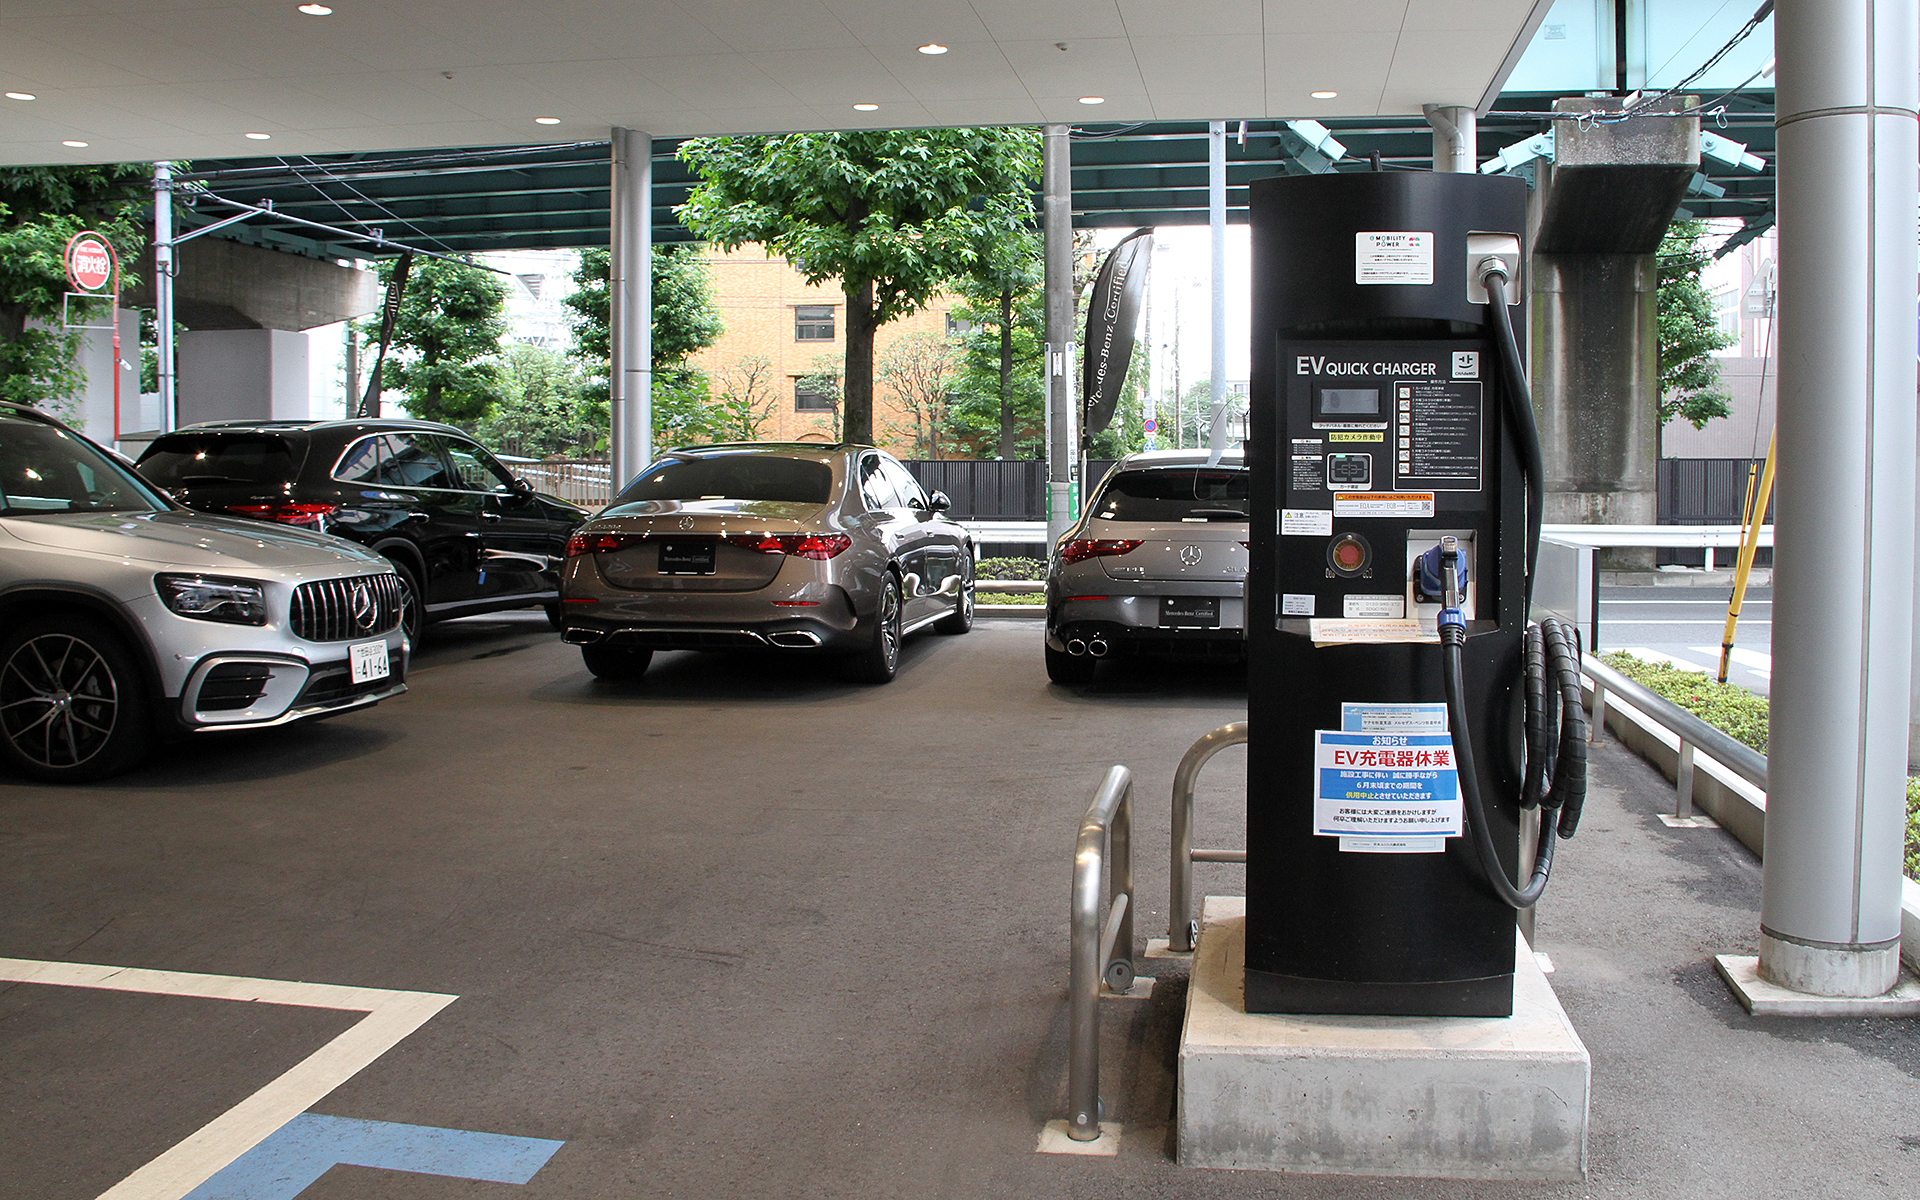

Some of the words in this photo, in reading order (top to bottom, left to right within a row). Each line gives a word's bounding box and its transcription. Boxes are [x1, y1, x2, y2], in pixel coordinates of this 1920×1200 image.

[76, 254, 108, 275] 消火栓
[1106, 260, 1129, 319] Certified
[1296, 356, 1326, 376] EV
[1326, 362, 1370, 376] QUICK
[1372, 362, 1437, 376] CHARGER
[362, 656, 388, 678] 41-64
[1372, 736, 1408, 746] お知らせ
[1334, 750, 1450, 767] EV充電器休業
[1340, 770, 1388, 779] 施設工事に伴い
[1392, 771, 1438, 780] 誠に勝手ながら
[1333, 816, 1450, 824] 何卒ご理解いただけますようお願い申し上げます
[1339, 808, 1437, 816] お客様には大変ご迷惑をおかけしますが
